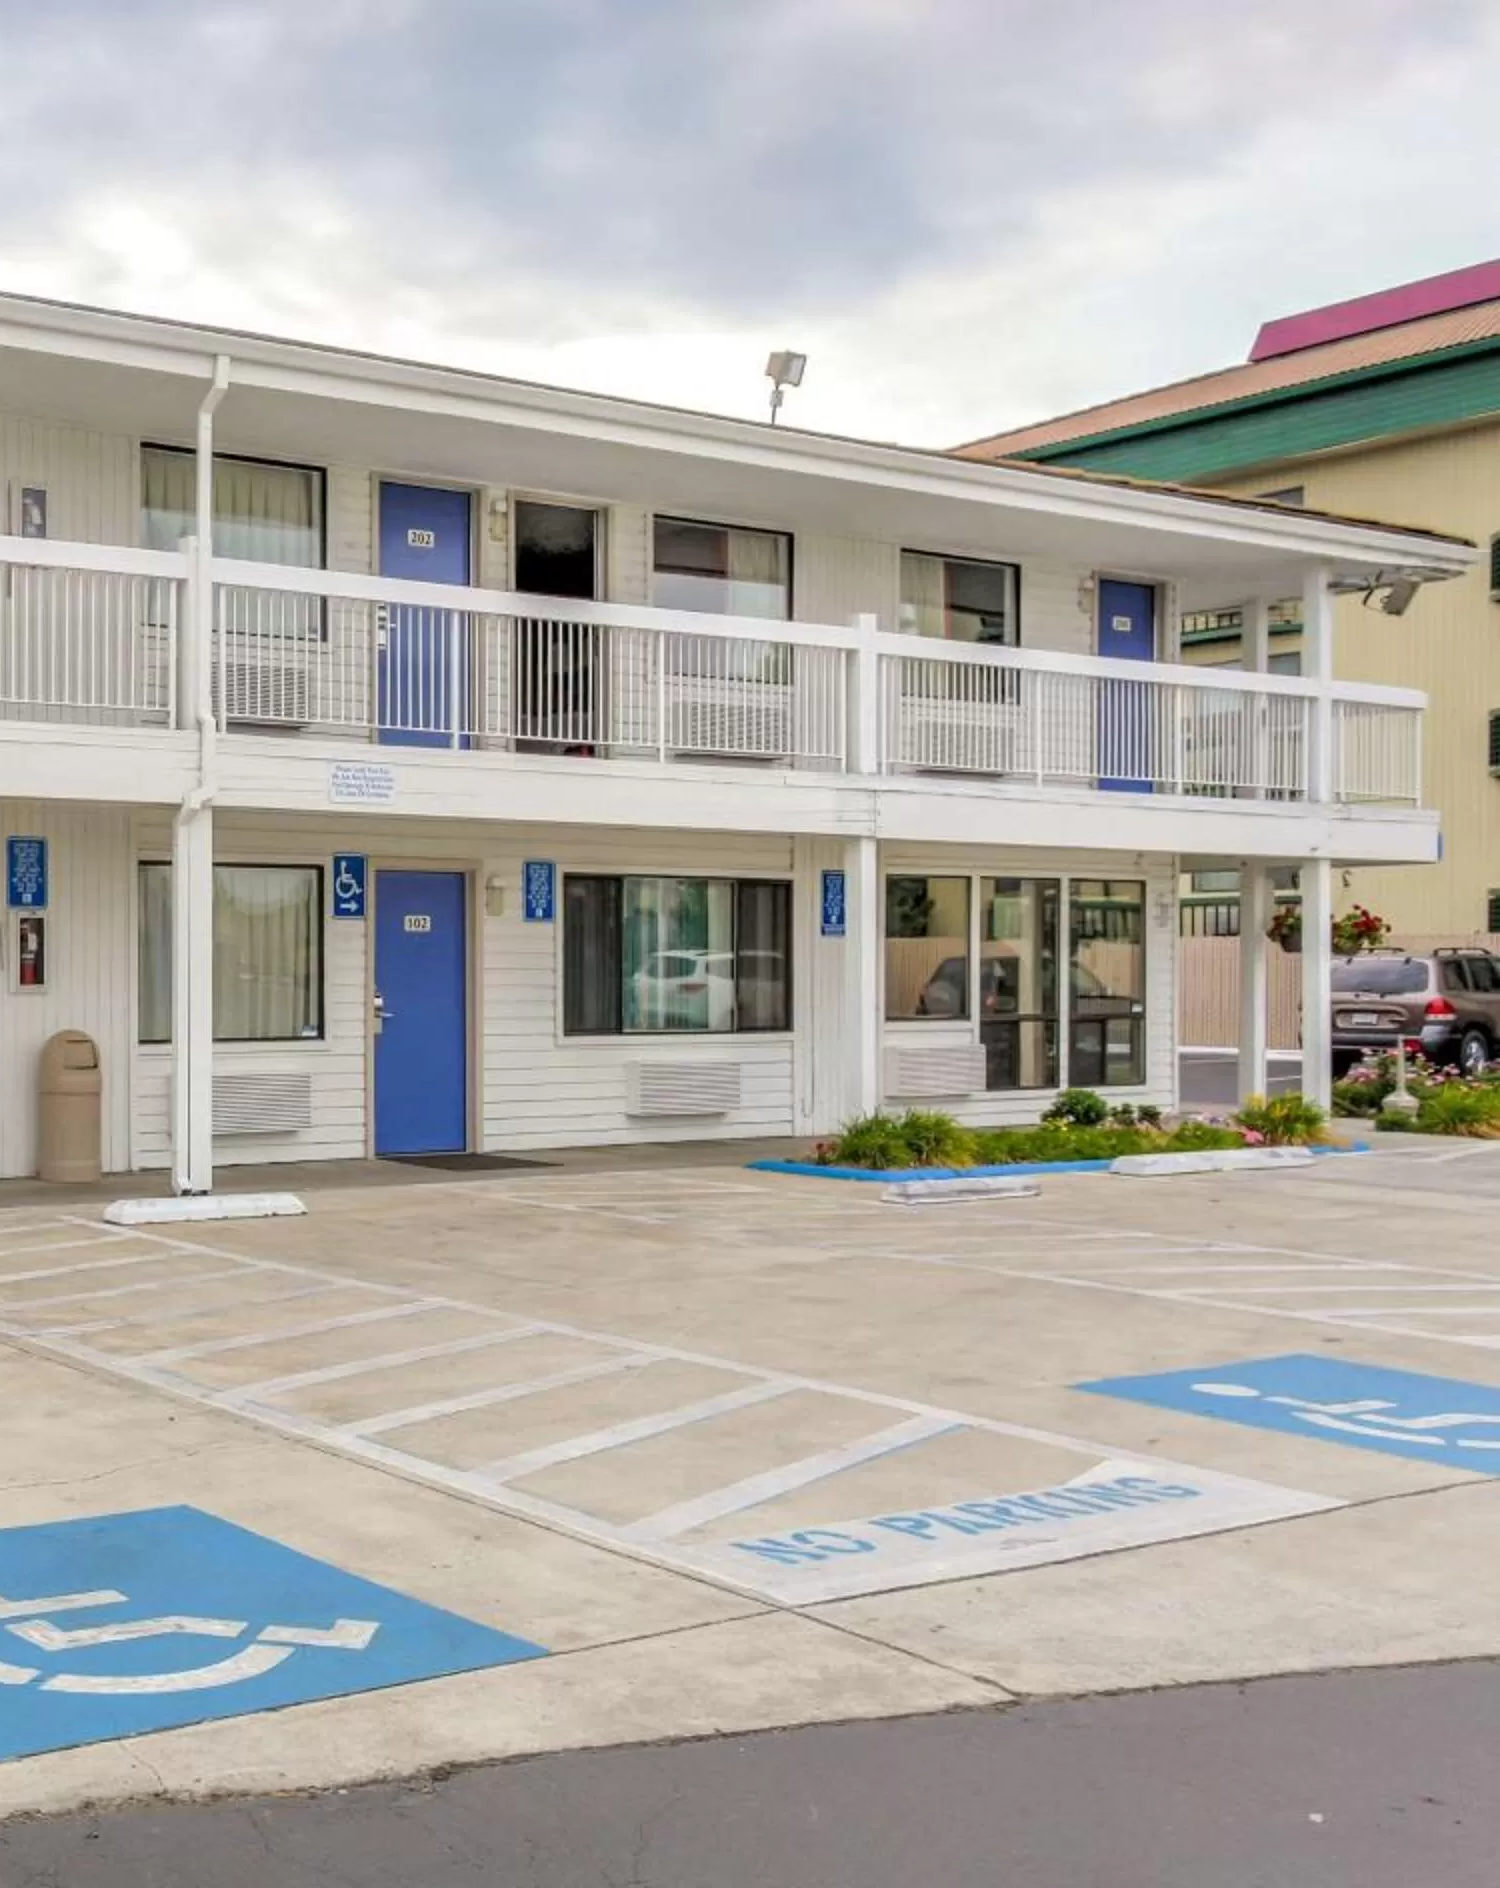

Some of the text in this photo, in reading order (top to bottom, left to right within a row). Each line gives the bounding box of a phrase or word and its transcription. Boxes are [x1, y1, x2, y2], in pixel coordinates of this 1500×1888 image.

[411, 531, 432, 545] 202
[409, 917, 428, 930] 102
[730, 1476, 1203, 1566] NO PARKING
